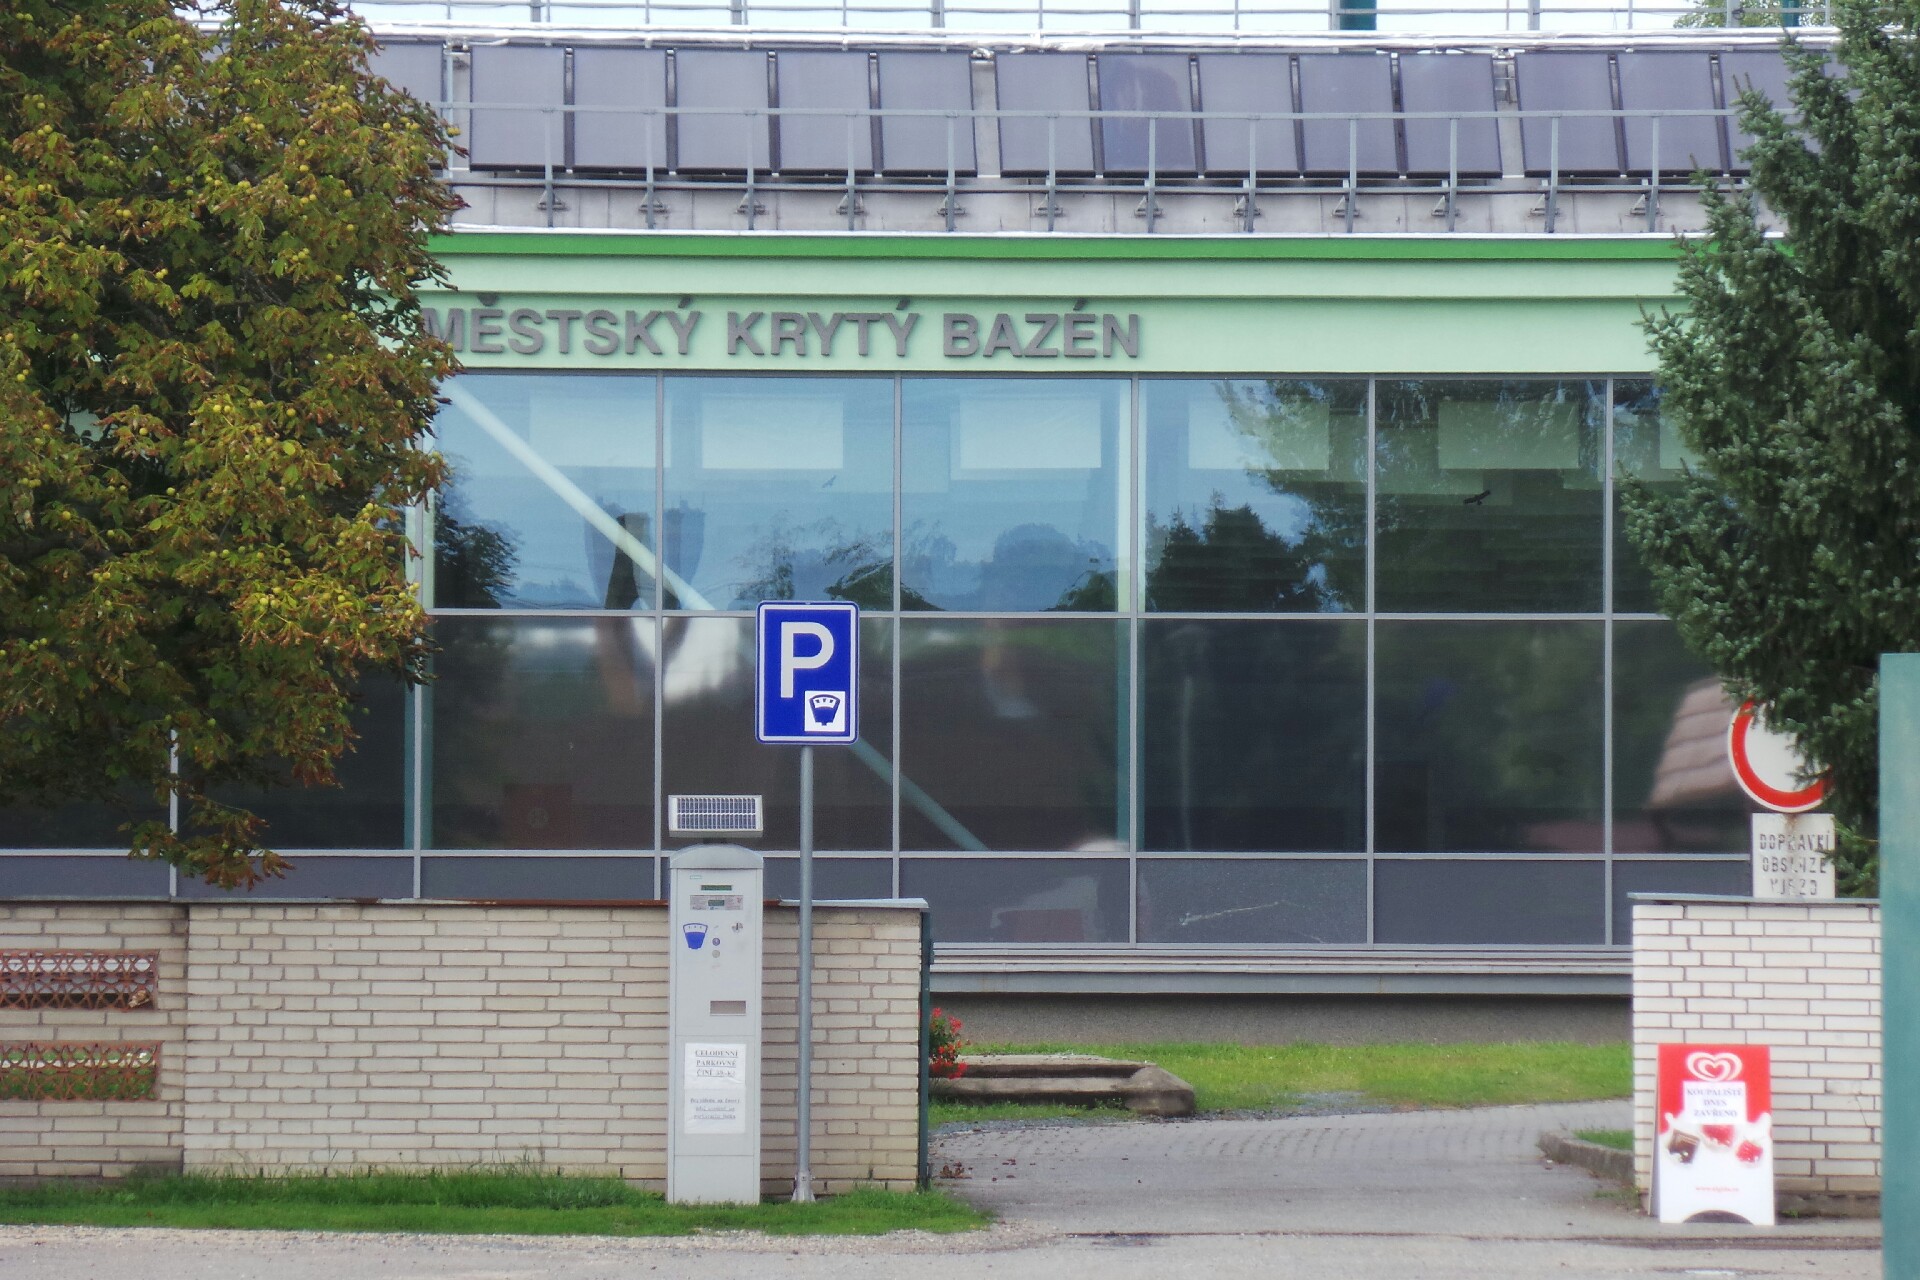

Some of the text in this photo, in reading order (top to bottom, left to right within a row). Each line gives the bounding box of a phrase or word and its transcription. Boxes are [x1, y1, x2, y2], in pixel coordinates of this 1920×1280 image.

[422, 293, 1139, 359] MĚSTSKÝ KRYTÝ BAZÉN
[781, 622, 835, 698] P
[696, 1059, 737, 1067] PARKOVNÉ
[1694, 1108, 1738, 1117] ZAVŘENO
